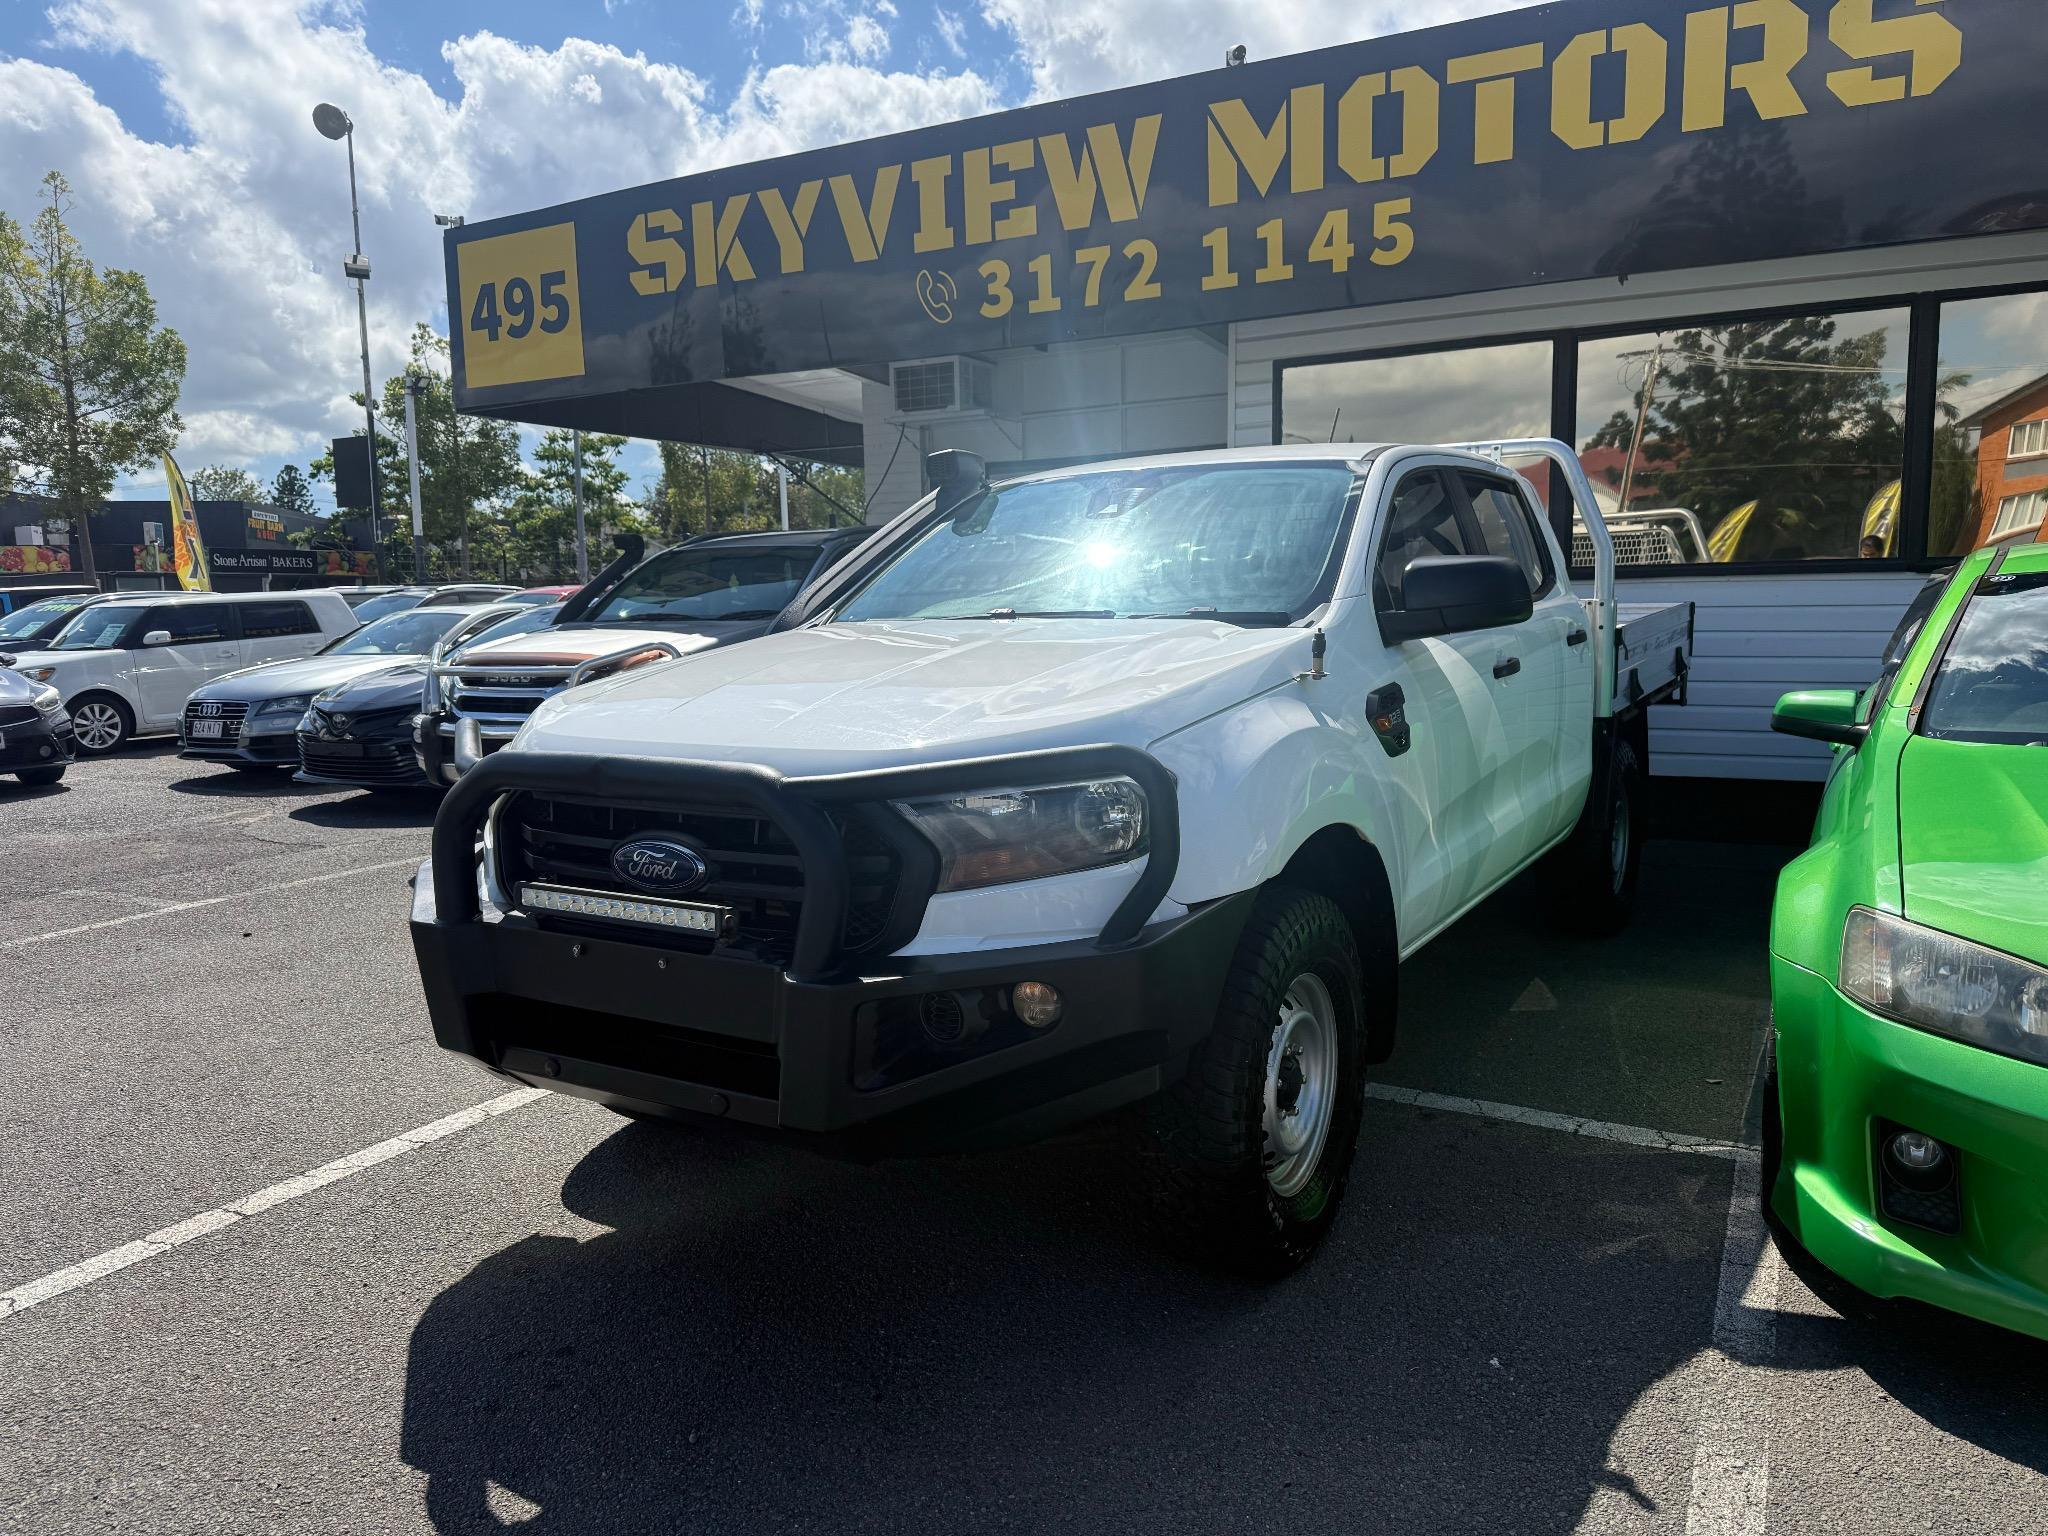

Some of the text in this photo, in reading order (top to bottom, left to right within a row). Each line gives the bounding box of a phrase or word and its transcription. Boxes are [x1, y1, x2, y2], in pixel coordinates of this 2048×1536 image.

[627, 0, 1962, 296] SKYVIEW MOTORS
[979, 197, 1415, 318] 3172 1145
[471, 270, 571, 342] 495
[213, 553, 238, 566] Stone
[239, 554, 267, 567] Artisan
[628, 849, 678, 880] Ford
